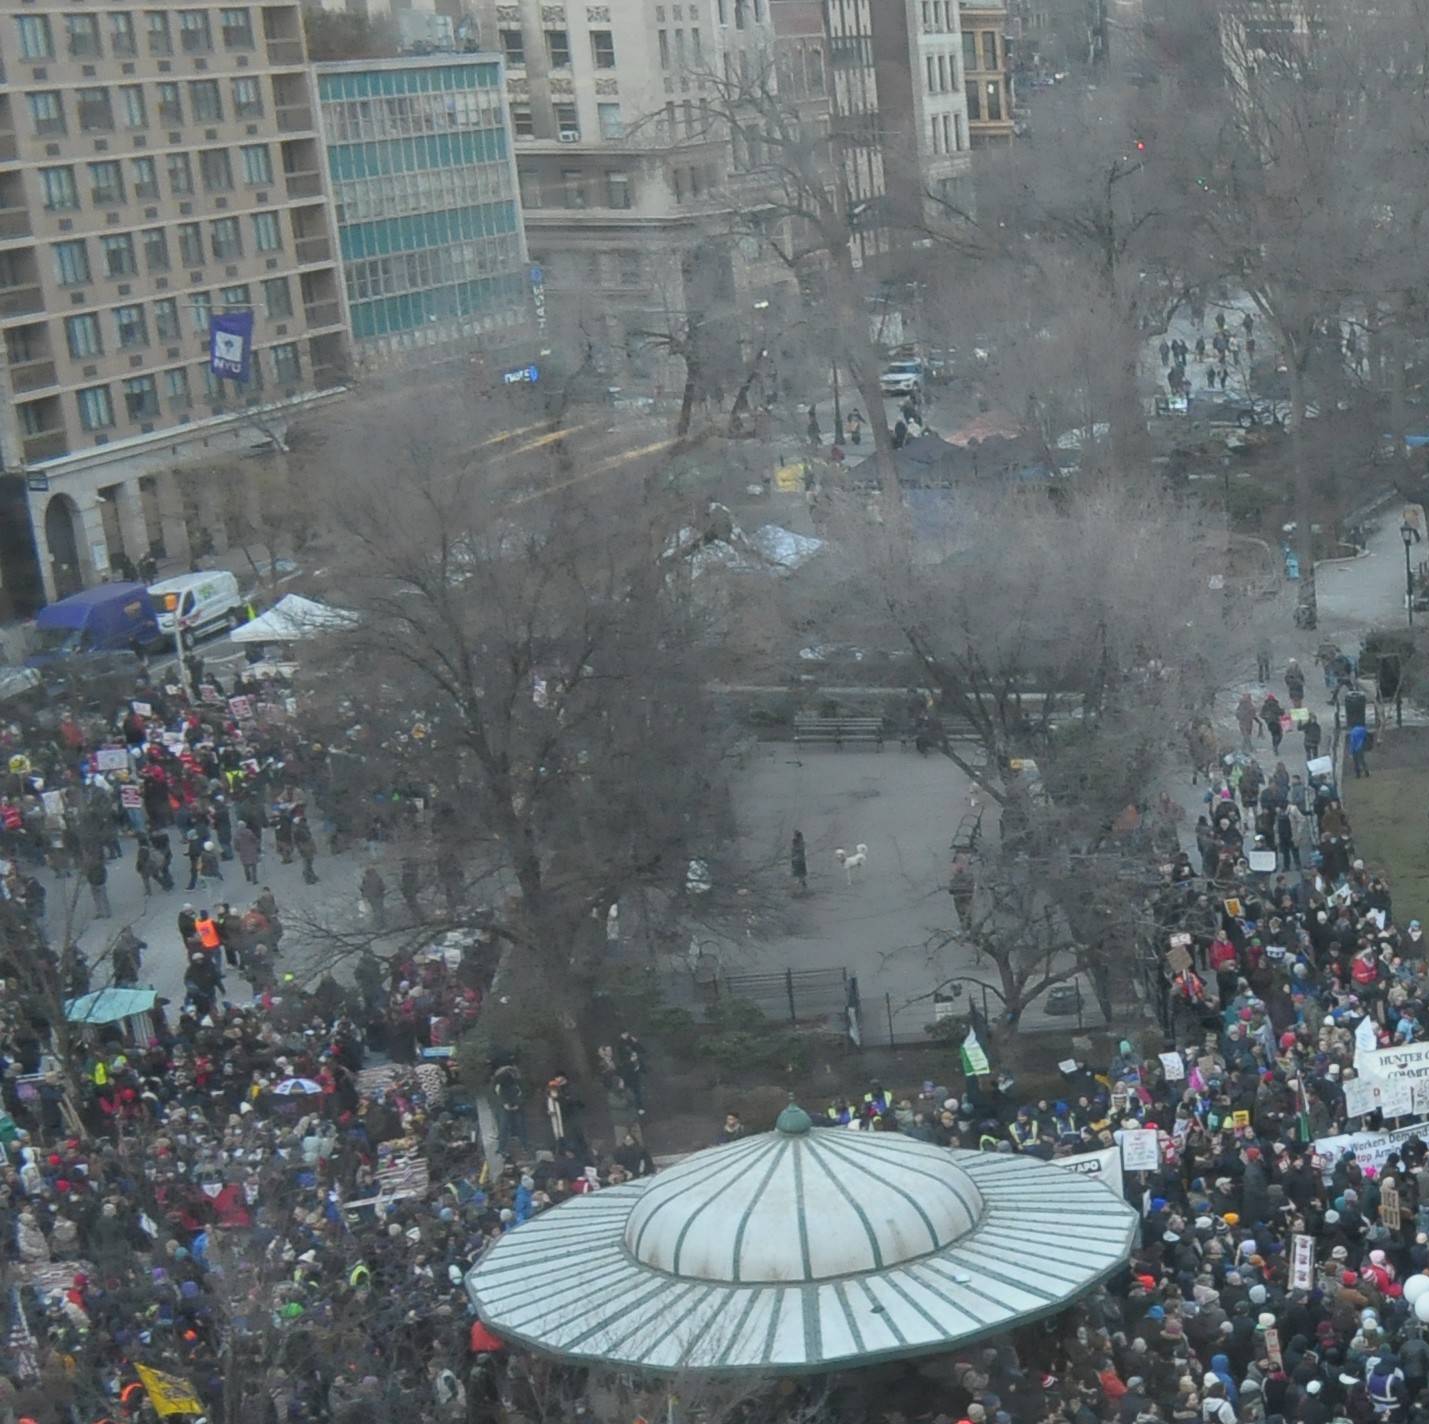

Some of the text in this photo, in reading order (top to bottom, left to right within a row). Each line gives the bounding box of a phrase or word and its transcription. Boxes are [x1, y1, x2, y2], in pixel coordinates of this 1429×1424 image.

[214, 358, 241, 373] NYU
[1379, 1052, 1422, 1066] HUNTER
[1071, 1160, 1099, 1173] TAPO
